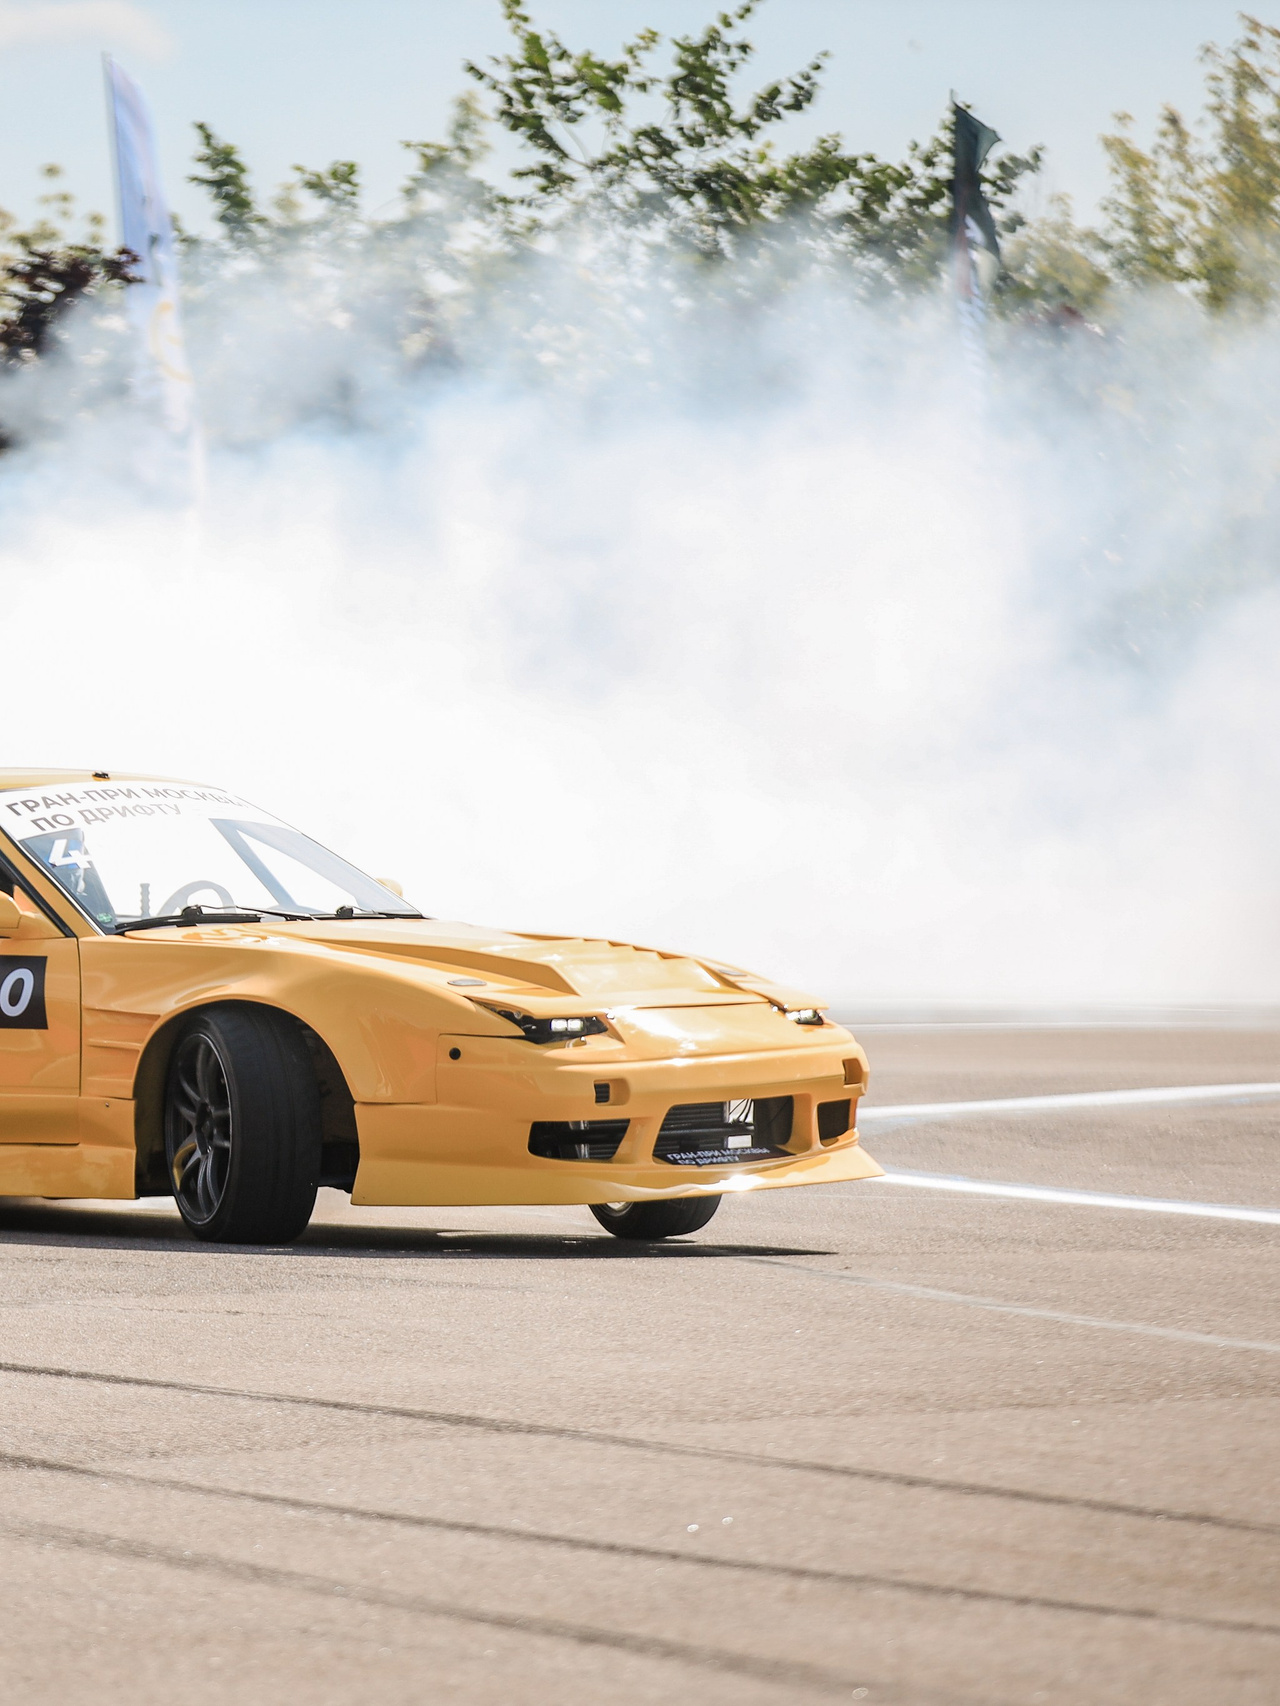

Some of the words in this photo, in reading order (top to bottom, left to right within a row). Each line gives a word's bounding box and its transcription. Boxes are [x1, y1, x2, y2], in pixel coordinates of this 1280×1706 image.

[6, 787, 141, 816] ГРАН-ПРИ
[31, 814, 75, 831] ПО
[78, 803, 182, 825] ДРИФТУ
[666, 1149, 722, 1161] ГРАН-ПРИ
